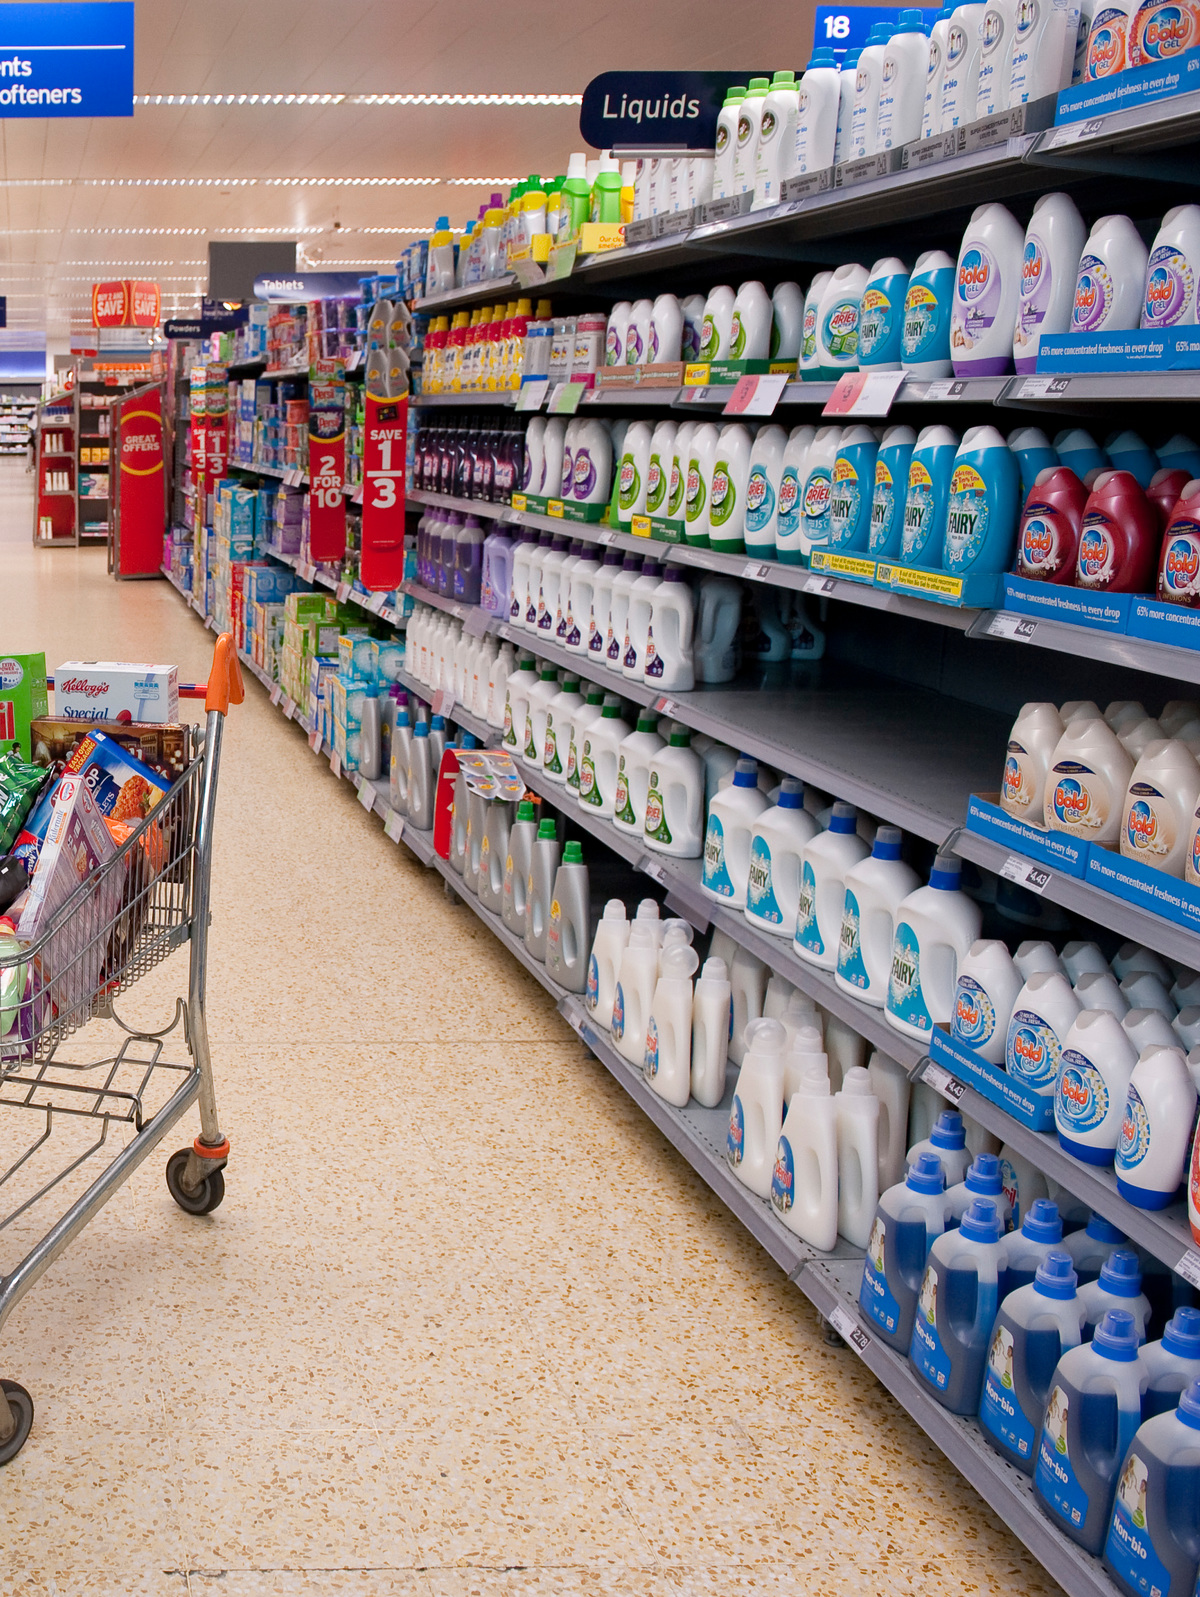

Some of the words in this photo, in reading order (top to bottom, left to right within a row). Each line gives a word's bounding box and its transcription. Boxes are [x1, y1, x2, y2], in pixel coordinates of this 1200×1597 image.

[824, 16, 850, 39] 18
[1148, 14, 1189, 43] Bold
[1163, 37, 1182, 49] GEL
[1089, 42, 1117, 66] Bold
[603, 94, 700, 123] Liquids
[959, 262, 989, 285] Bold
[262, 280, 304, 291] Tablets
[967, 284, 980, 293] GEL
[1147, 280, 1173, 302] Bold
[1074, 287, 1097, 307] Bold
[97, 301, 124, 317] SAVE
[134, 301, 157, 317] SAVE
[830, 311, 858, 327] ARIEL
[168, 324, 200, 334] Powders
[861, 323, 880, 339] FAIRY
[905, 321, 925, 337] FAIRY
[1040, 346, 1051, 356] 65%
[1051, 347, 1064, 356] more
[1064, 345, 1097, 356] concentrated
[1098, 343, 1123, 355] freshness
[1124, 344, 1131, 353] in
[1131, 343, 1149, 355] every
[1148, 342, 1164, 355] drop
[316, 361, 336, 373] Persil
[314, 388, 336, 401] Persil
[318, 415, 341, 430] Persil
[126, 434, 156, 445] GREAT
[212, 438, 220, 452] 1
[370, 429, 403, 441] SAVE
[123, 442, 160, 453] OFFERS
[378, 440, 392, 470] 1
[209, 457, 224, 475] 3
[320, 456, 336, 476] 2
[313, 476, 341, 488] FOR
[311, 488, 342, 508] £10
[371, 478, 396, 509] 3
[806, 486, 830, 502] ARIEL
[949, 513, 978, 535] FAIRY
[1024, 530, 1051, 550] Bold
[1033, 548, 1046, 558] GEL
[1079, 541, 1107, 561] Bold
[1088, 560, 1101, 570] GEL
[1168, 551, 1199, 574] Bold
[61, 678, 110, 697] Kellogg's
[63, 705, 109, 719] Special
[69, 752, 83, 770] EASY
[79, 738, 91, 757] OPEN
[73, 741, 97, 773] PACKAGING
[1056, 788, 1088, 812] Bold
[1067, 808, 1082, 818] GEL
[970, 804, 980, 815] 65%
[979, 808, 992, 821] more
[992, 812, 1023, 834] concentrated
[1022, 828, 1045, 846] freshness
[1045, 838, 1051, 848] in
[1051, 839, 1065, 855] every
[1065, 845, 1079, 860] drop
[1130, 813, 1155, 836] Bold
[1137, 832, 1149, 843] GEL
[750, 863, 768, 887] FAIRY
[1030, 869, 1047, 886] £4.43
[891, 957, 916, 985] FAIRY
[956, 1000, 978, 1025] Bold
[1015, 1036, 1043, 1063] Bold
[948, 1078, 964, 1098] £4.43
[1062, 1076, 1089, 1105] Bold
[775, 1158, 792, 1189] Persil
[852, 1327, 869, 1349] £2.78
[915, 1318, 936, 1352] Non-bio
[985, 1378, 1016, 1417] Non-bio
[1039, 1442, 1069, 1486] Non-bio
[1113, 1516, 1148, 1561] Non-bio
